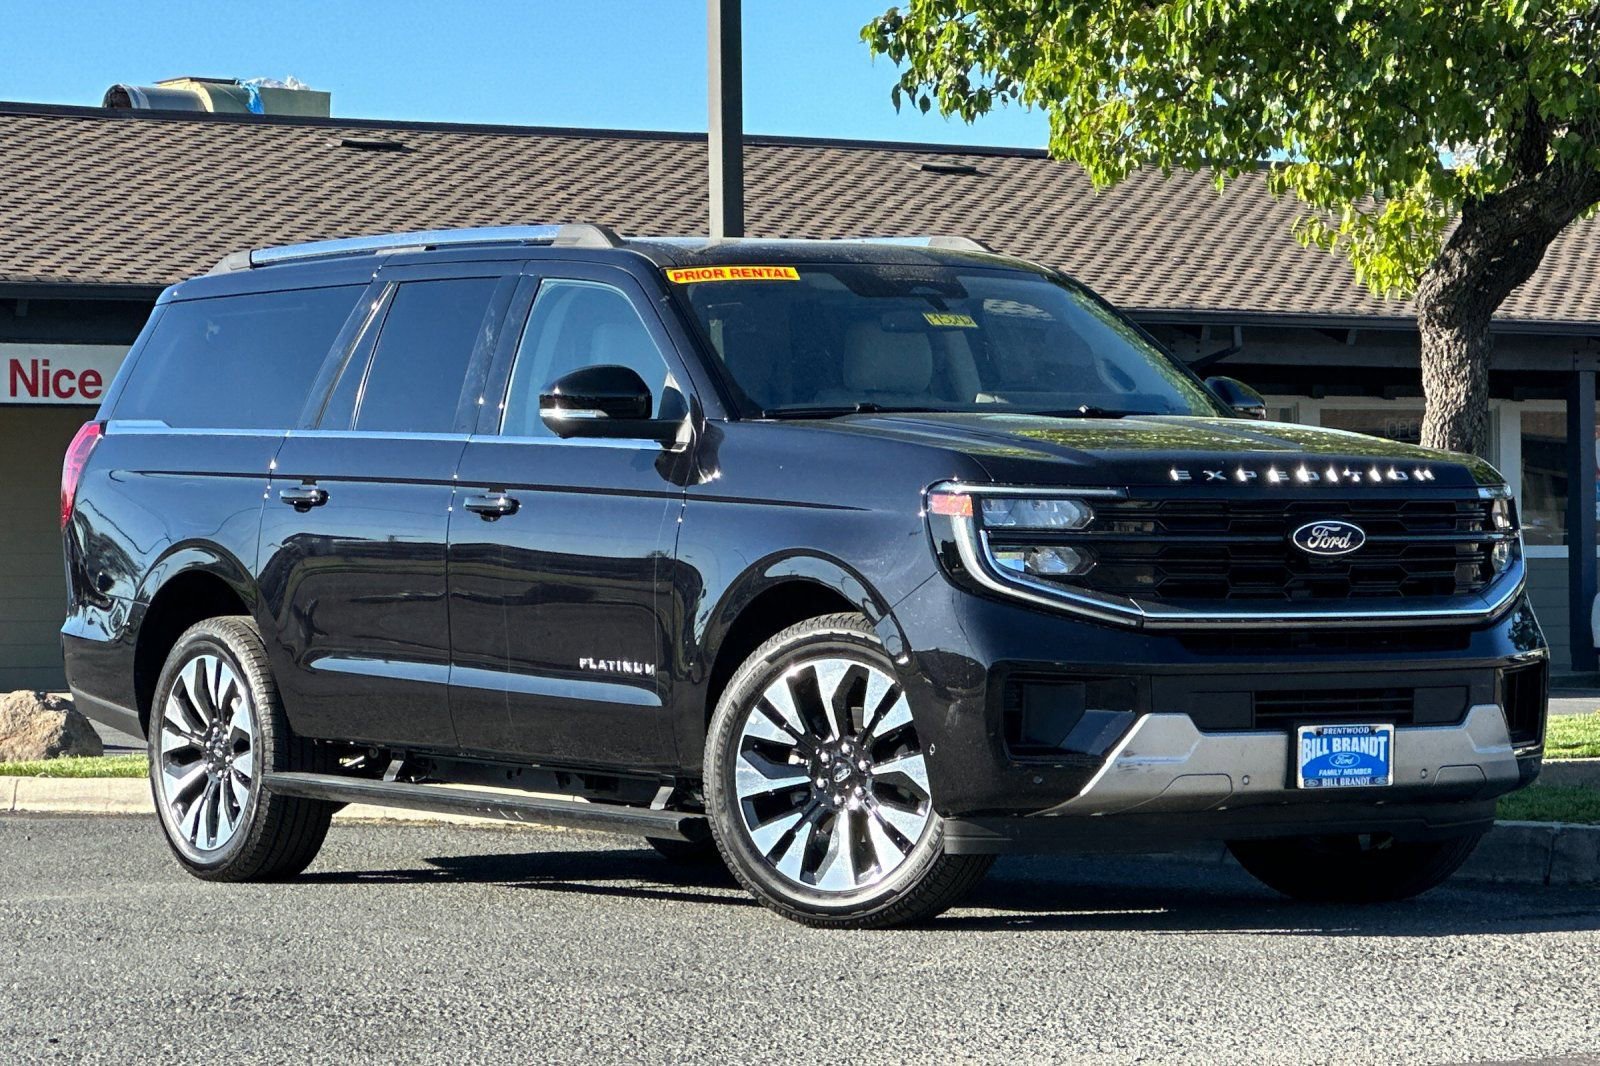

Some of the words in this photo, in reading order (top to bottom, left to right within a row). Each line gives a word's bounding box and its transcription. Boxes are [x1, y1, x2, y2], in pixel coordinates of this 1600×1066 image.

[674, 269, 725, 282] PRIOR
[730, 268, 796, 279] RENTAL
[9, 358, 103, 399] Nice
[1170, 466, 1436, 483] EXPEDITION
[1307, 525, 1352, 549] Ford
[579, 657, 655, 677] PLATINUM
[1323, 726, 1370, 735] BRENTWOOD
[1302, 738, 1330, 766] BILL
[1332, 736, 1388, 762] BRANDT
[1318, 768, 1341, 777] FAMILY
[1343, 767, 1372, 776] MEMBER
[1322, 778, 1339, 787] BILL
[1340, 776, 1371, 787] BRANDT
